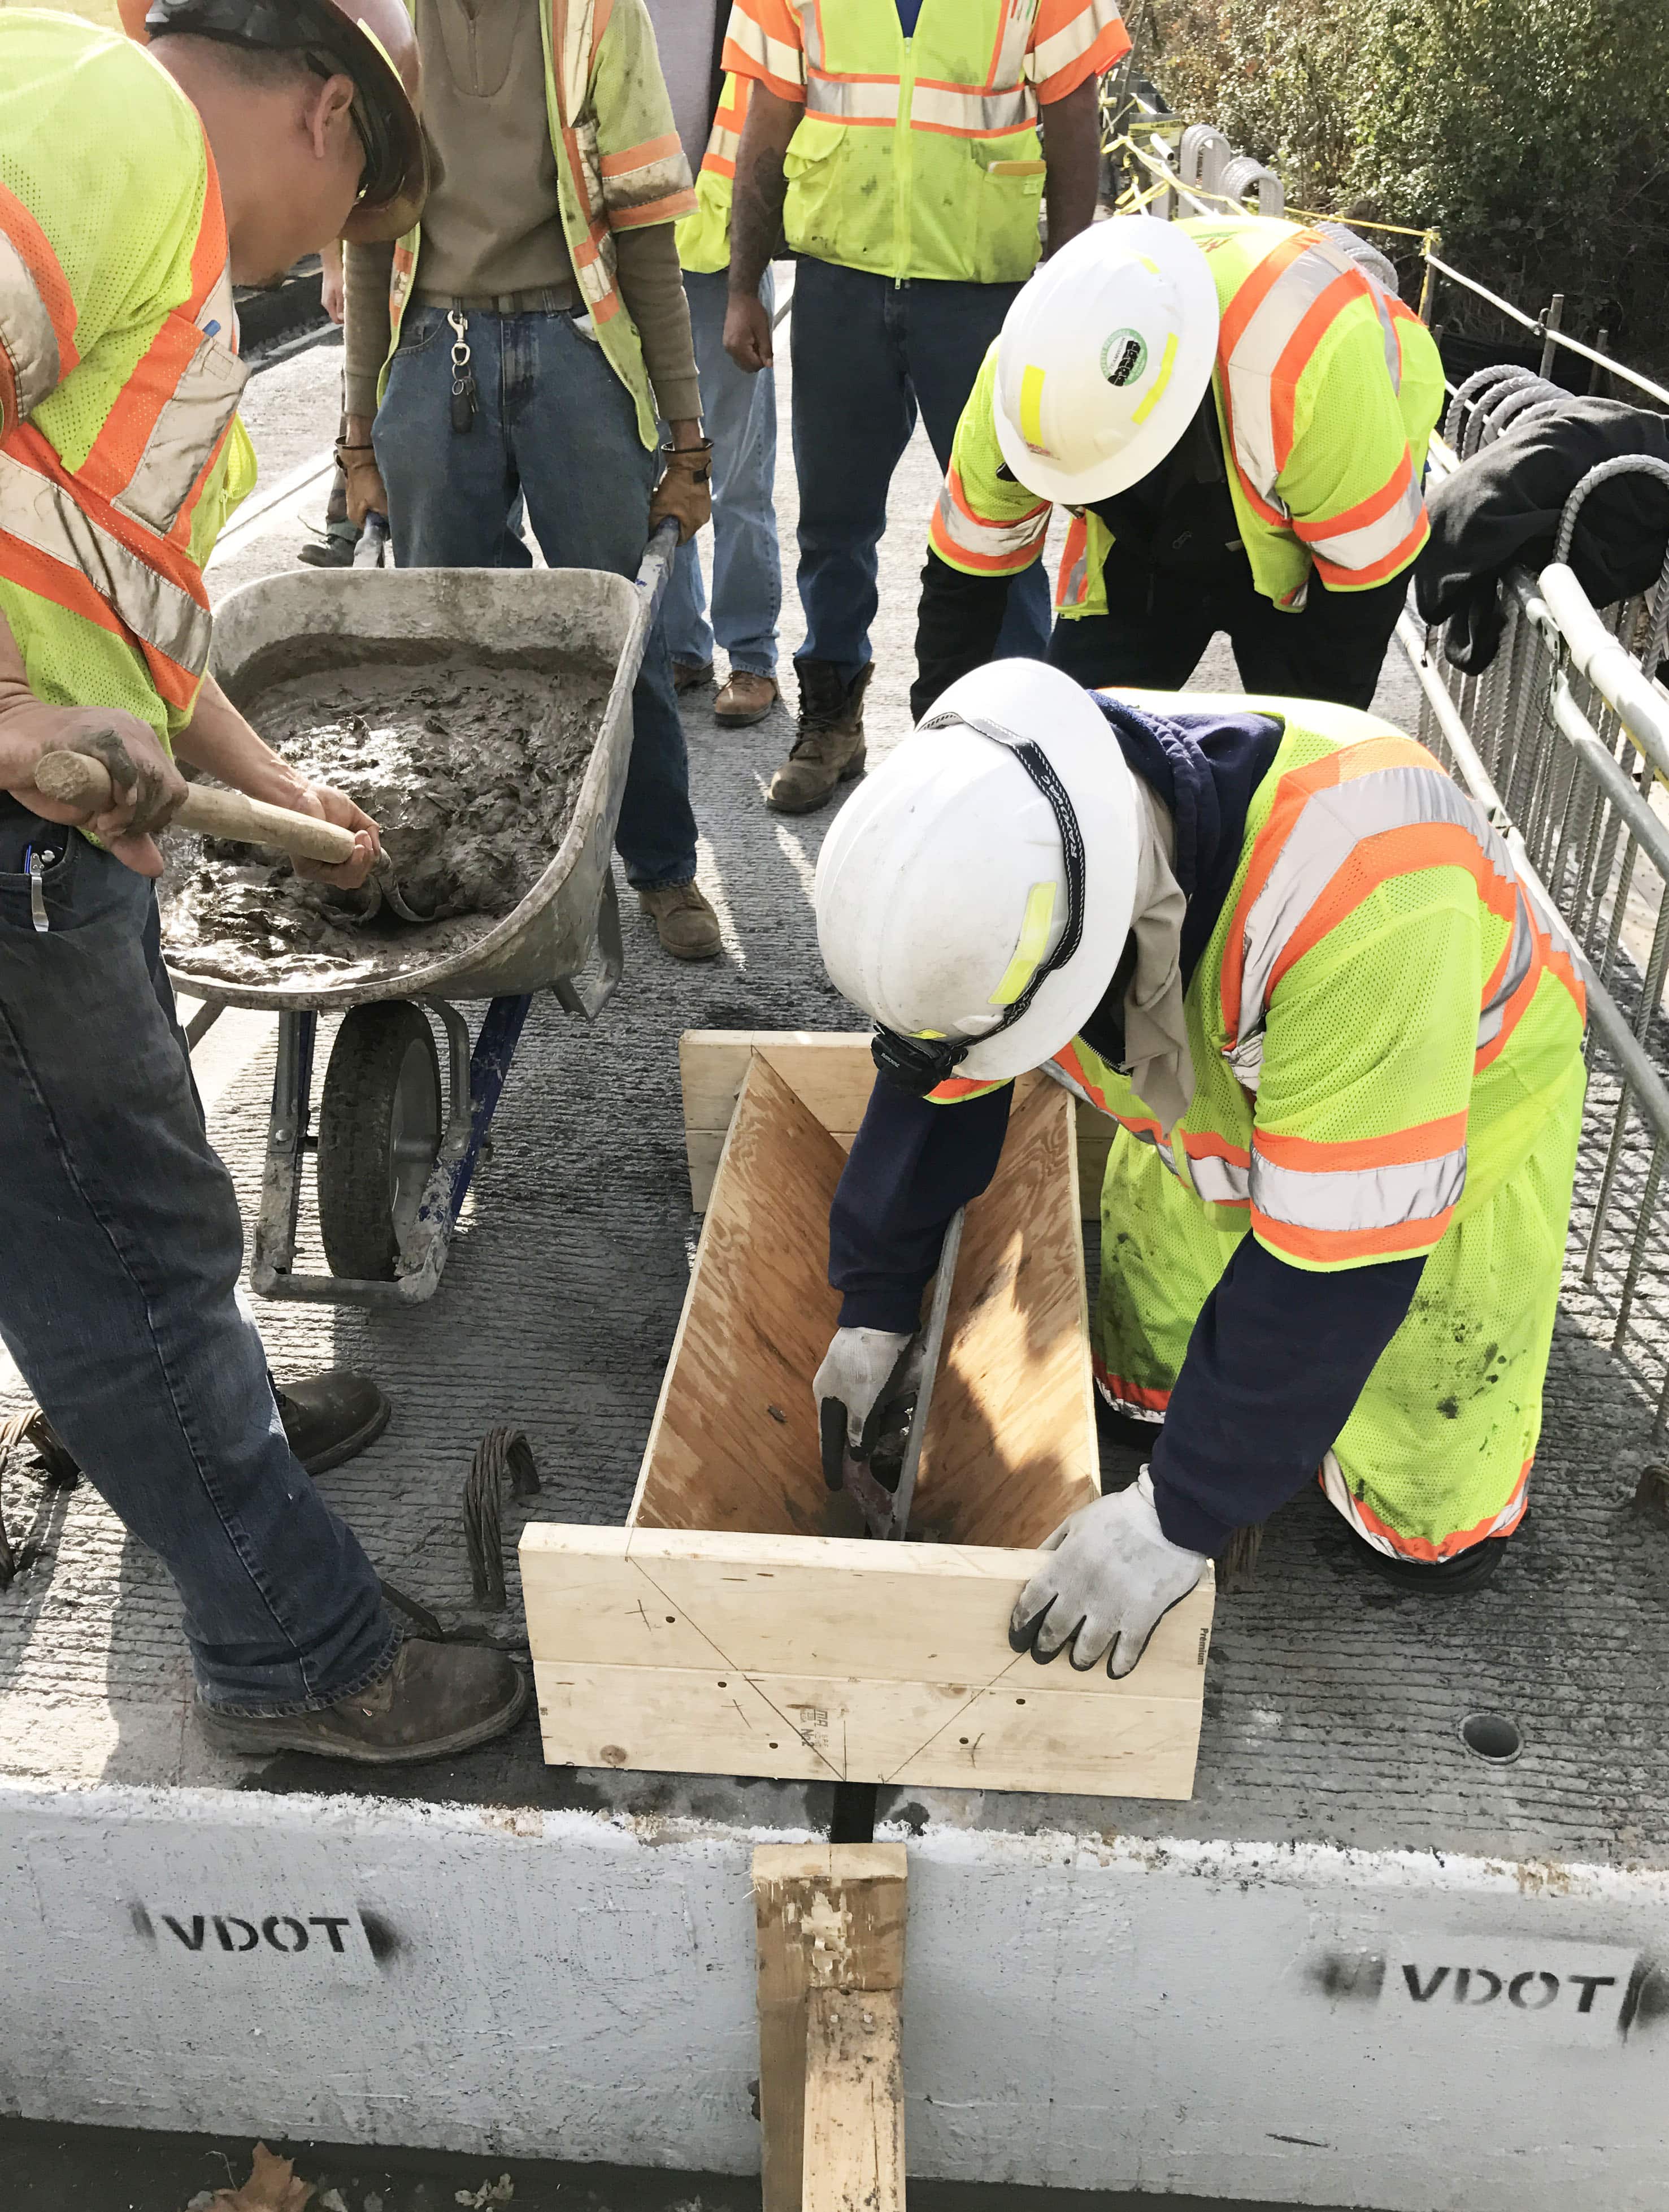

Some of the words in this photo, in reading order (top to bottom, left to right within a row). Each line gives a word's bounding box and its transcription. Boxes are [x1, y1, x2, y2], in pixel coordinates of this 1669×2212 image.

[1041, 775, 1077, 858] RAYOVAC
[162, 1915, 350, 1953] VDOT
[1402, 1964, 1616, 2013] VDOT
